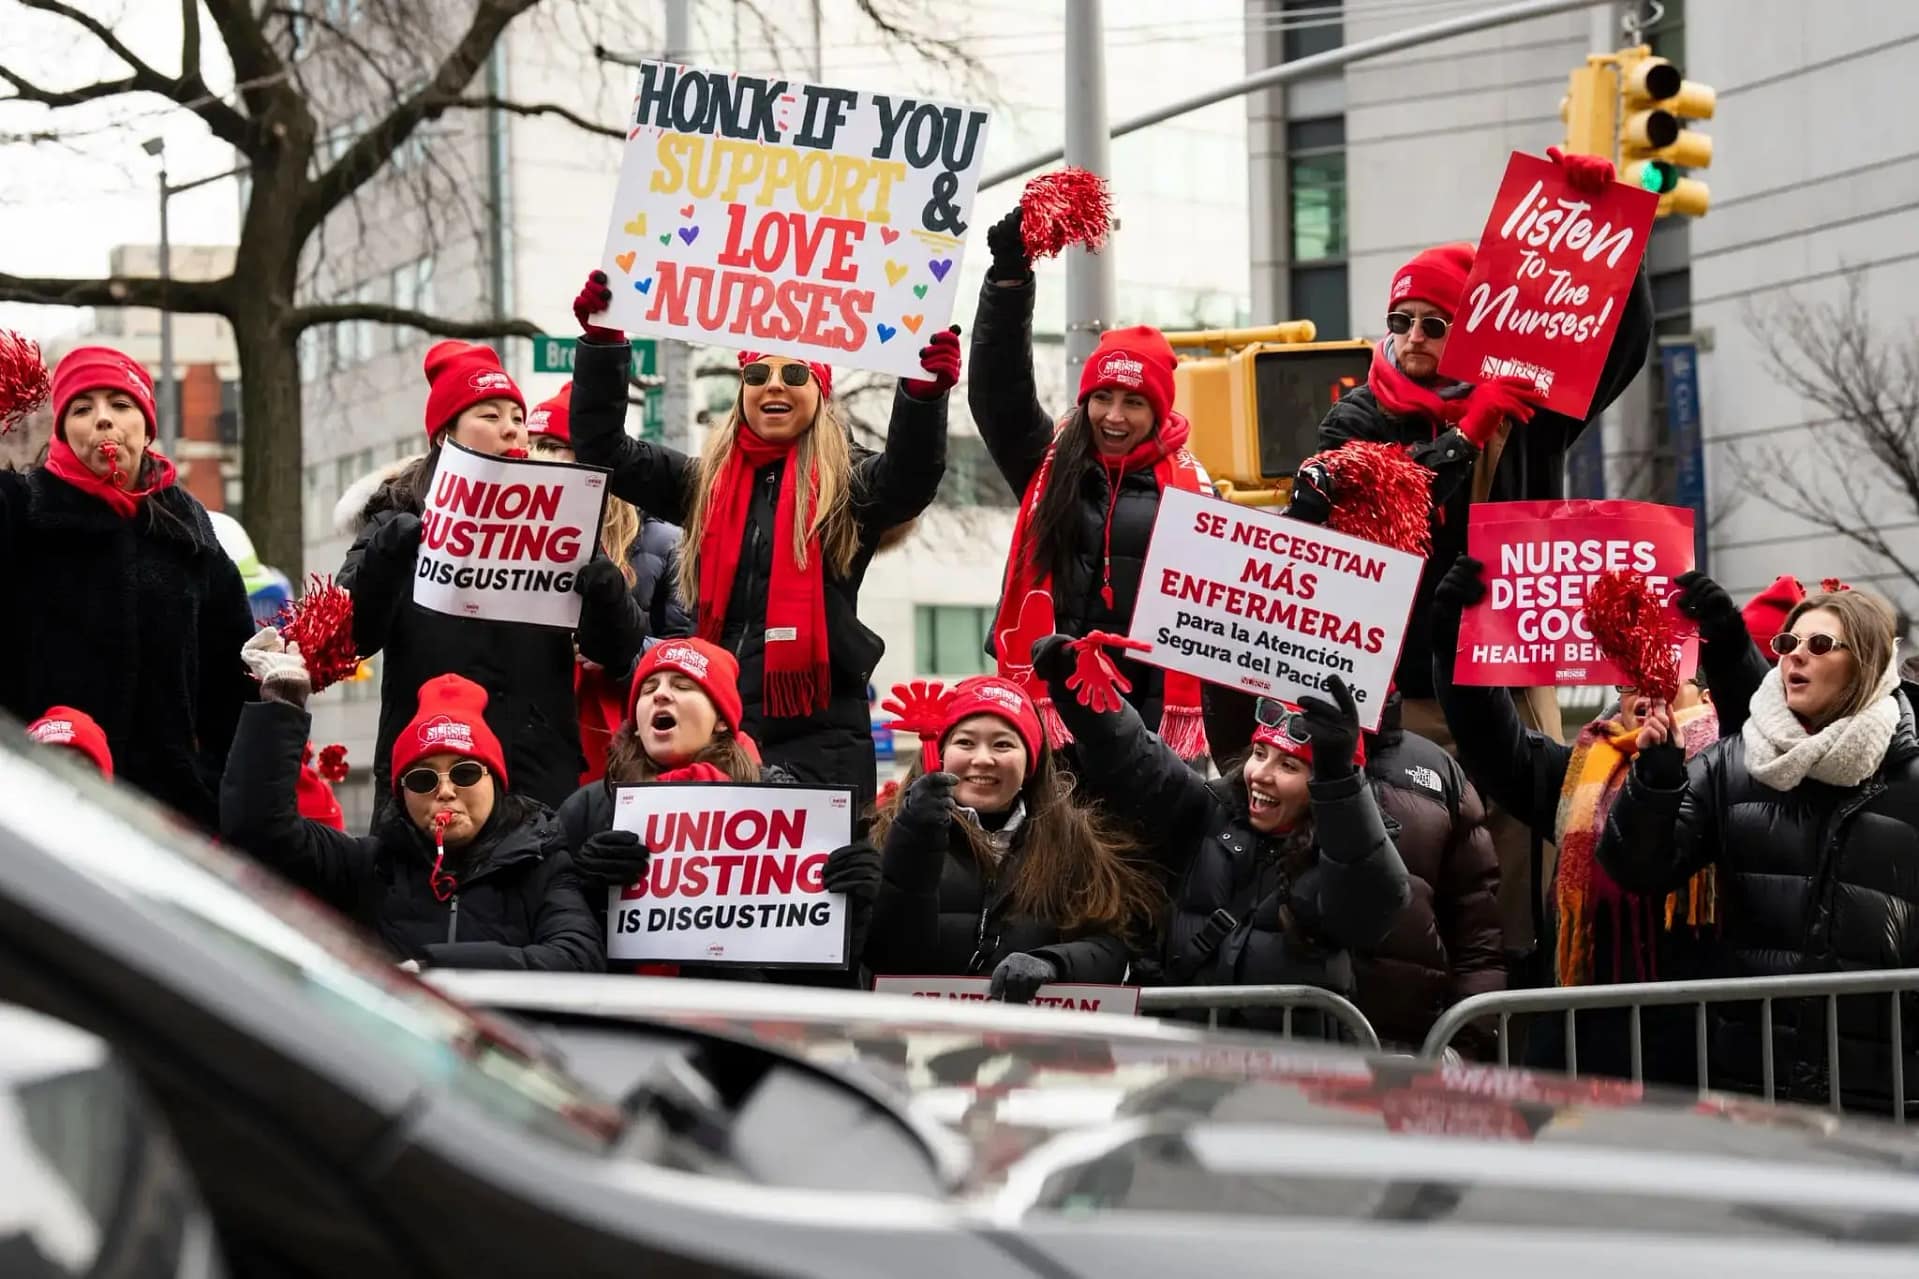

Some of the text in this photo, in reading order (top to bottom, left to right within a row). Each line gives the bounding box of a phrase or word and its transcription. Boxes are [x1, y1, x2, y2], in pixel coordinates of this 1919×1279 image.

[636, 63, 987, 171] HONK IF YOU
[650, 133, 968, 237] SUPPORT &
[717, 203, 866, 283] LOVE
[645, 261, 875, 353] NURSES
[1466, 282, 1614, 343] Nurses!
[1544, 268, 1590, 306] The
[435, 471, 564, 521] UNION
[420, 509, 583, 563] BUSTING
[1194, 512, 1386, 583] SE NECESITAN
[1501, 540, 1657, 575] NURSES
[418, 556, 574, 593] DISGUSTING
[1240, 558, 1318, 600] MÁS
[1491, 575, 1669, 610] DESEE
[1160, 568, 1385, 654] ENFERMERAS
[1517, 609, 1596, 642] GOO
[1156, 627, 1232, 663] Segura
[1237, 651, 1270, 674] del
[1276, 660, 1368, 703] Paciete
[1176, 610, 1354, 673] para la Atención
[1471, 644, 1555, 664] HEALTH
[645, 809, 808, 854] UNION
[616, 902, 831, 934] IS DISGUSTING
